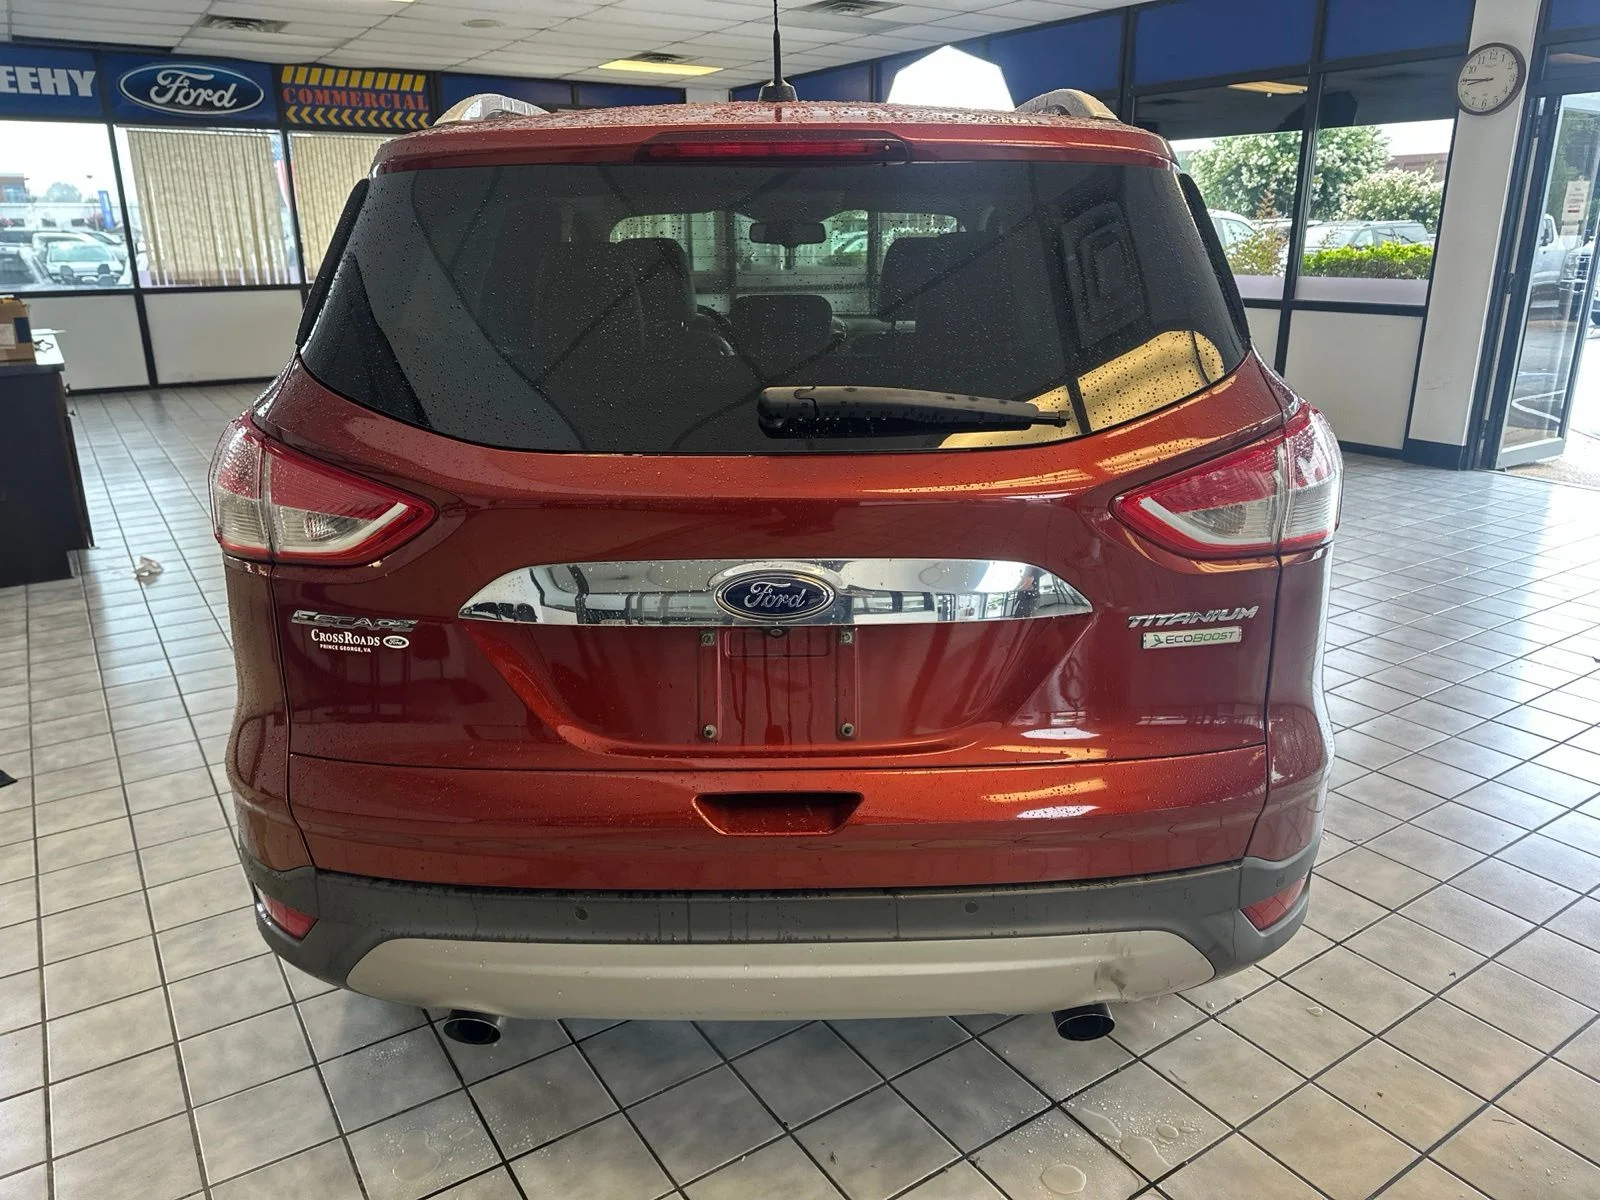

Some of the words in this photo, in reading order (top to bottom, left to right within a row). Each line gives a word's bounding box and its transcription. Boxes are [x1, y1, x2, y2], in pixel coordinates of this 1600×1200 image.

[1478, 56, 1485, 64] 11
[1489, 52, 1498, 60] 12
[1501, 54, 1505, 62] 1
[149, 68, 237, 109] Ford
[282, 87, 430, 112] COMMERCIAL
[744, 581, 807, 608] Ford
[1128, 605, 1260, 628] TITANIUM
[1165, 631, 1236, 645] ECOBOOST
